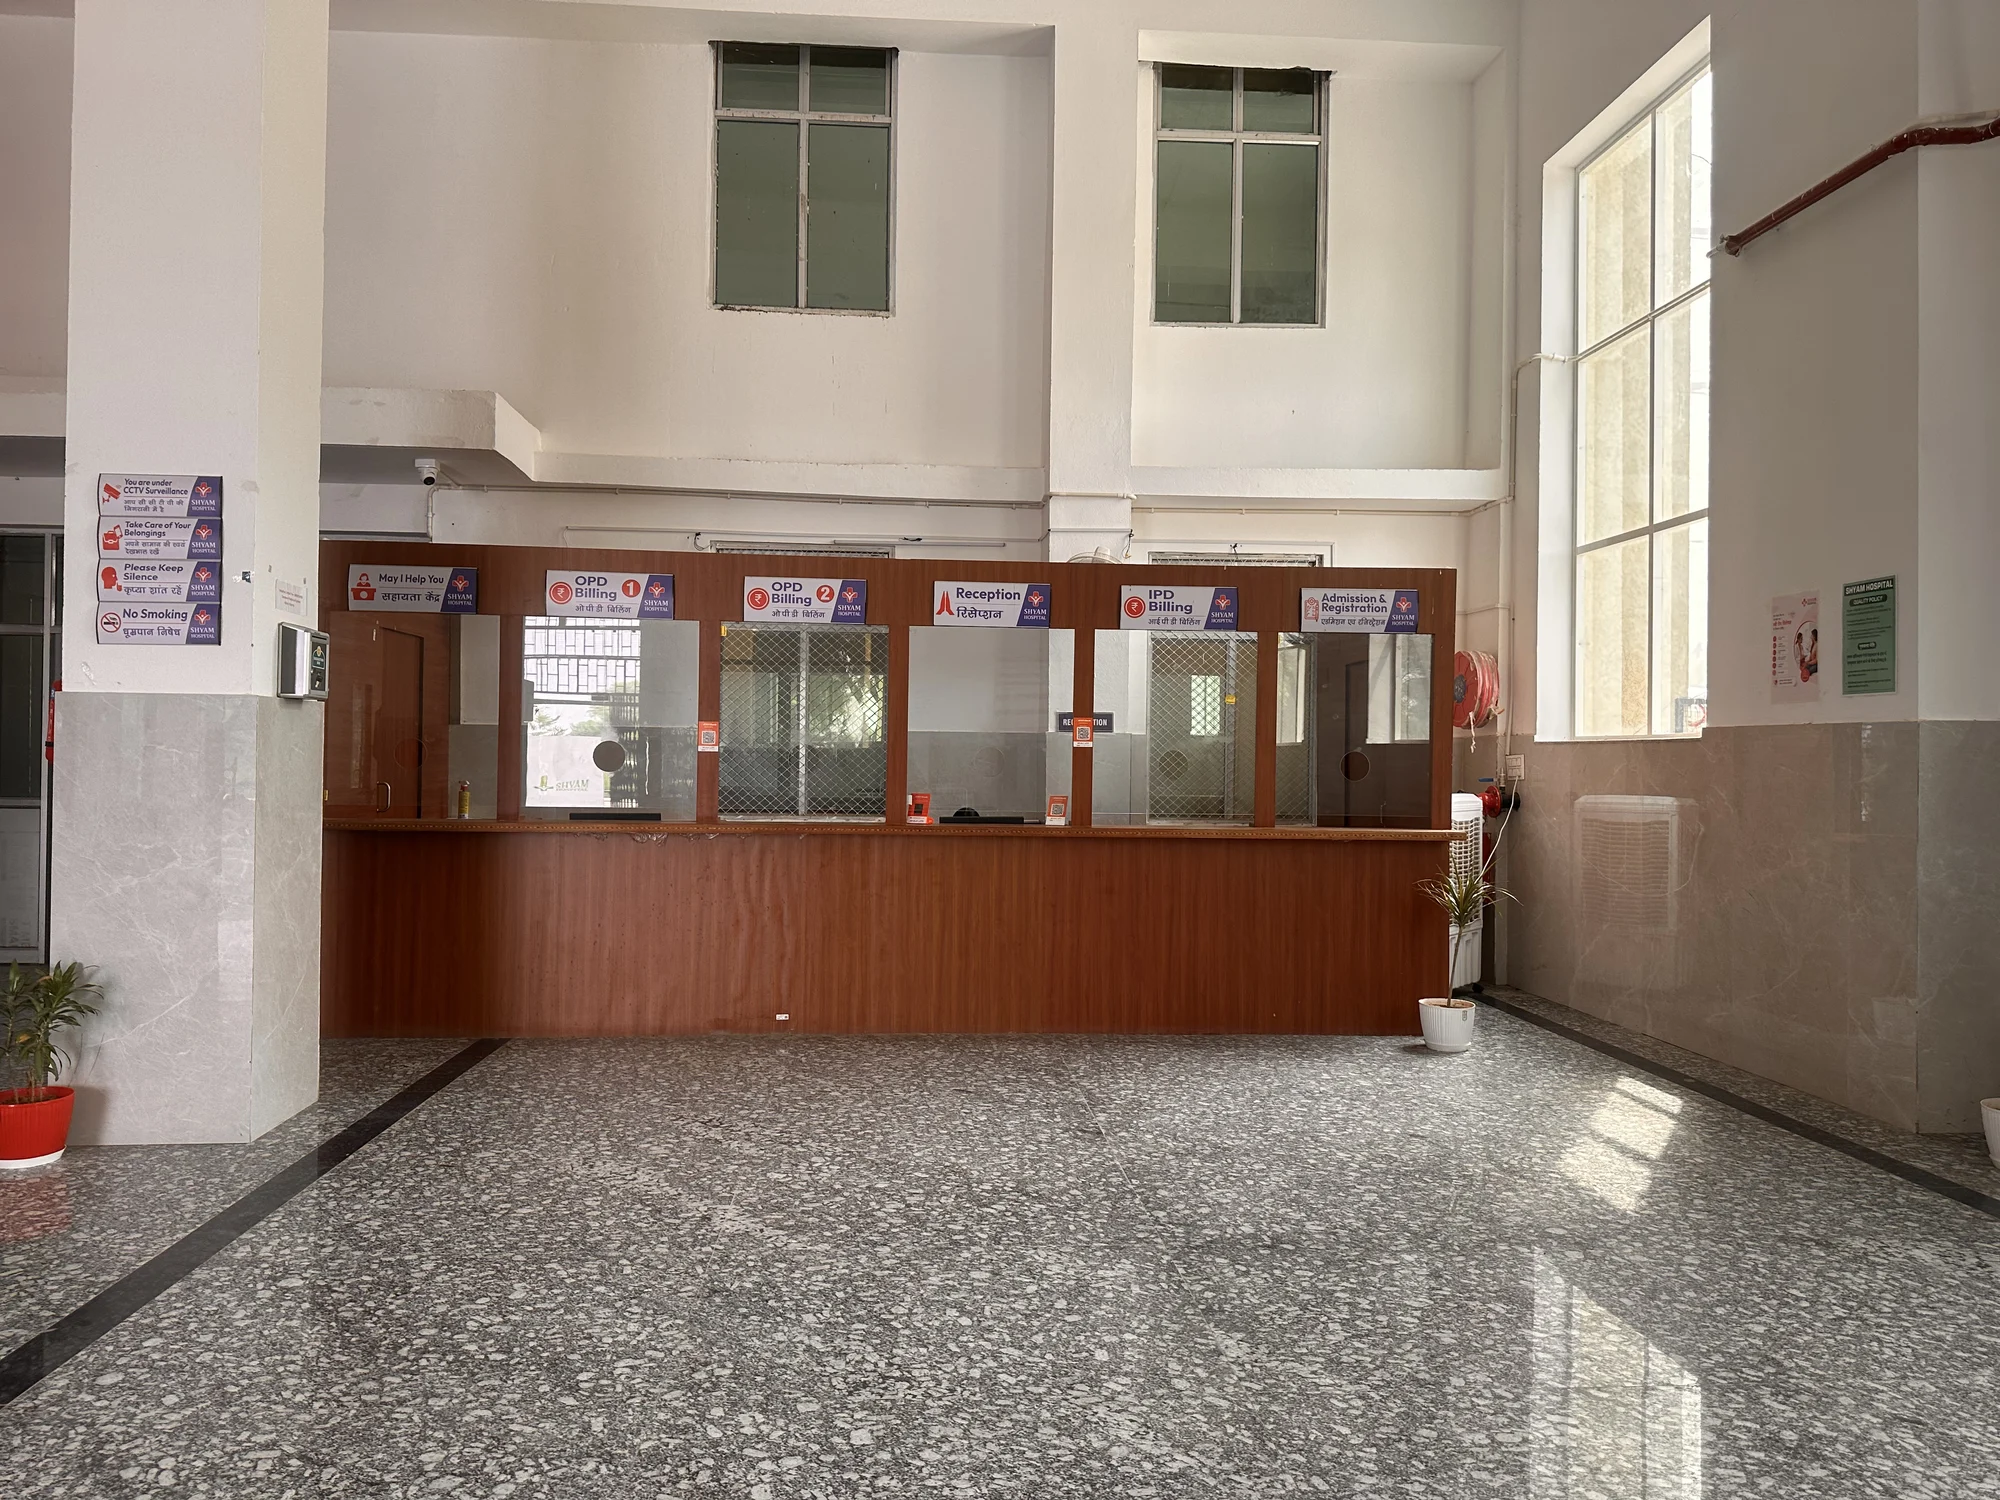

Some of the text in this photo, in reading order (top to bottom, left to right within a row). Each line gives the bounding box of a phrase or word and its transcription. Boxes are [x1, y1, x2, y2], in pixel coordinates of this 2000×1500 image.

[125, 530, 166, 538] Belongings
[159, 564, 183, 573] Keep
[379, 574, 444, 585] May I Help You
[575, 576, 634, 595] OPD 1
[772, 582, 830, 600] OPD 2
[1846, 580, 1893, 594] SHYAM HOSPITAL
[381, 592, 422, 602] सहायता
[575, 588, 617, 601] Billing
[772, 594, 812, 606] Billing
[956, 588, 1020, 602] Reception
[1149, 590, 1174, 599] IPD
[1321, 593, 1386, 603] Admission &
[957, 606, 1003, 619] रिसेप्शन
[1149, 601, 1192, 614] Billing
[1322, 603, 1387, 614] Registration
[123, 609, 188, 621] No Smoking
